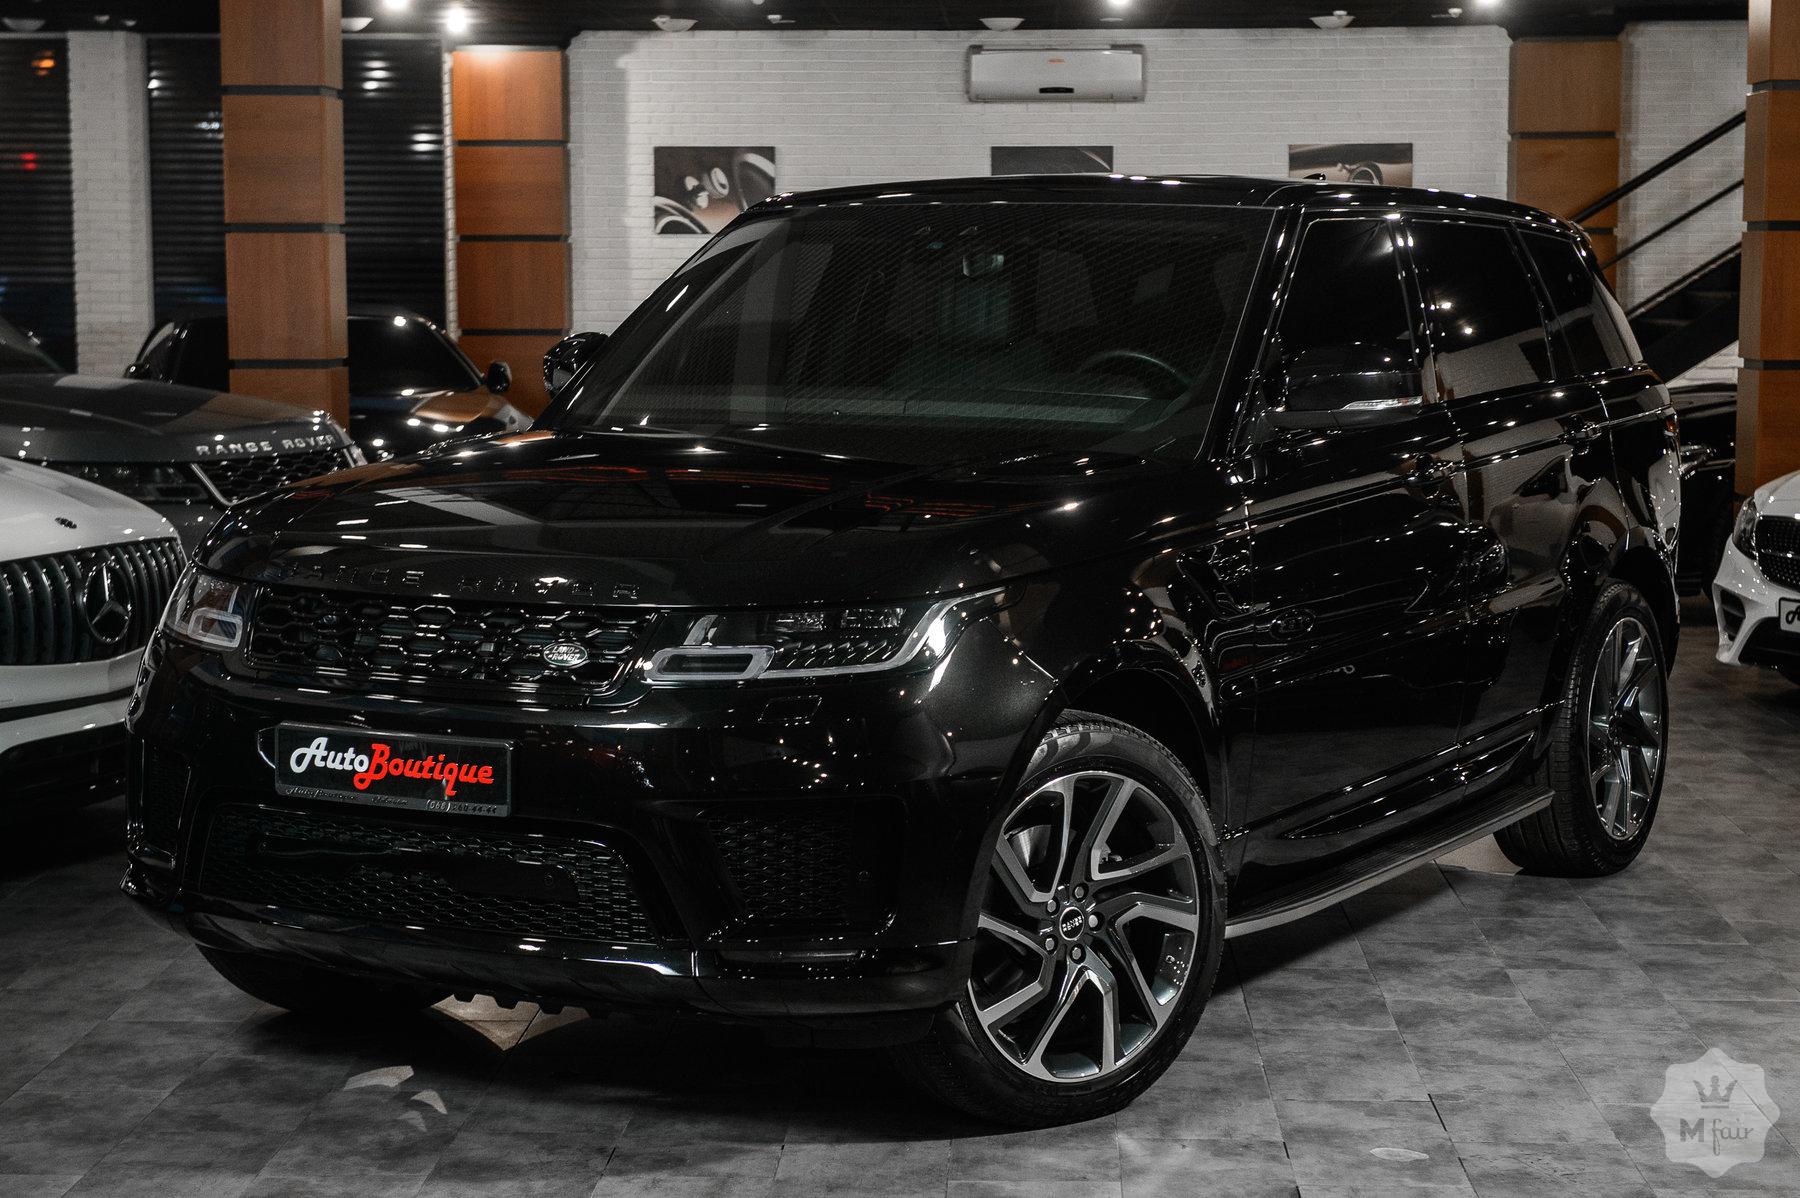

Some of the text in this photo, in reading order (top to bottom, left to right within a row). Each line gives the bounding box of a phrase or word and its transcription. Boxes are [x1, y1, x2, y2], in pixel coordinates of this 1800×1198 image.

[195, 433, 336, 456] RANGE ROVER
[551, 645, 576, 654] LAND
[551, 653, 581, 661] ROVER
[289, 736, 495, 797] AutoBoutique
